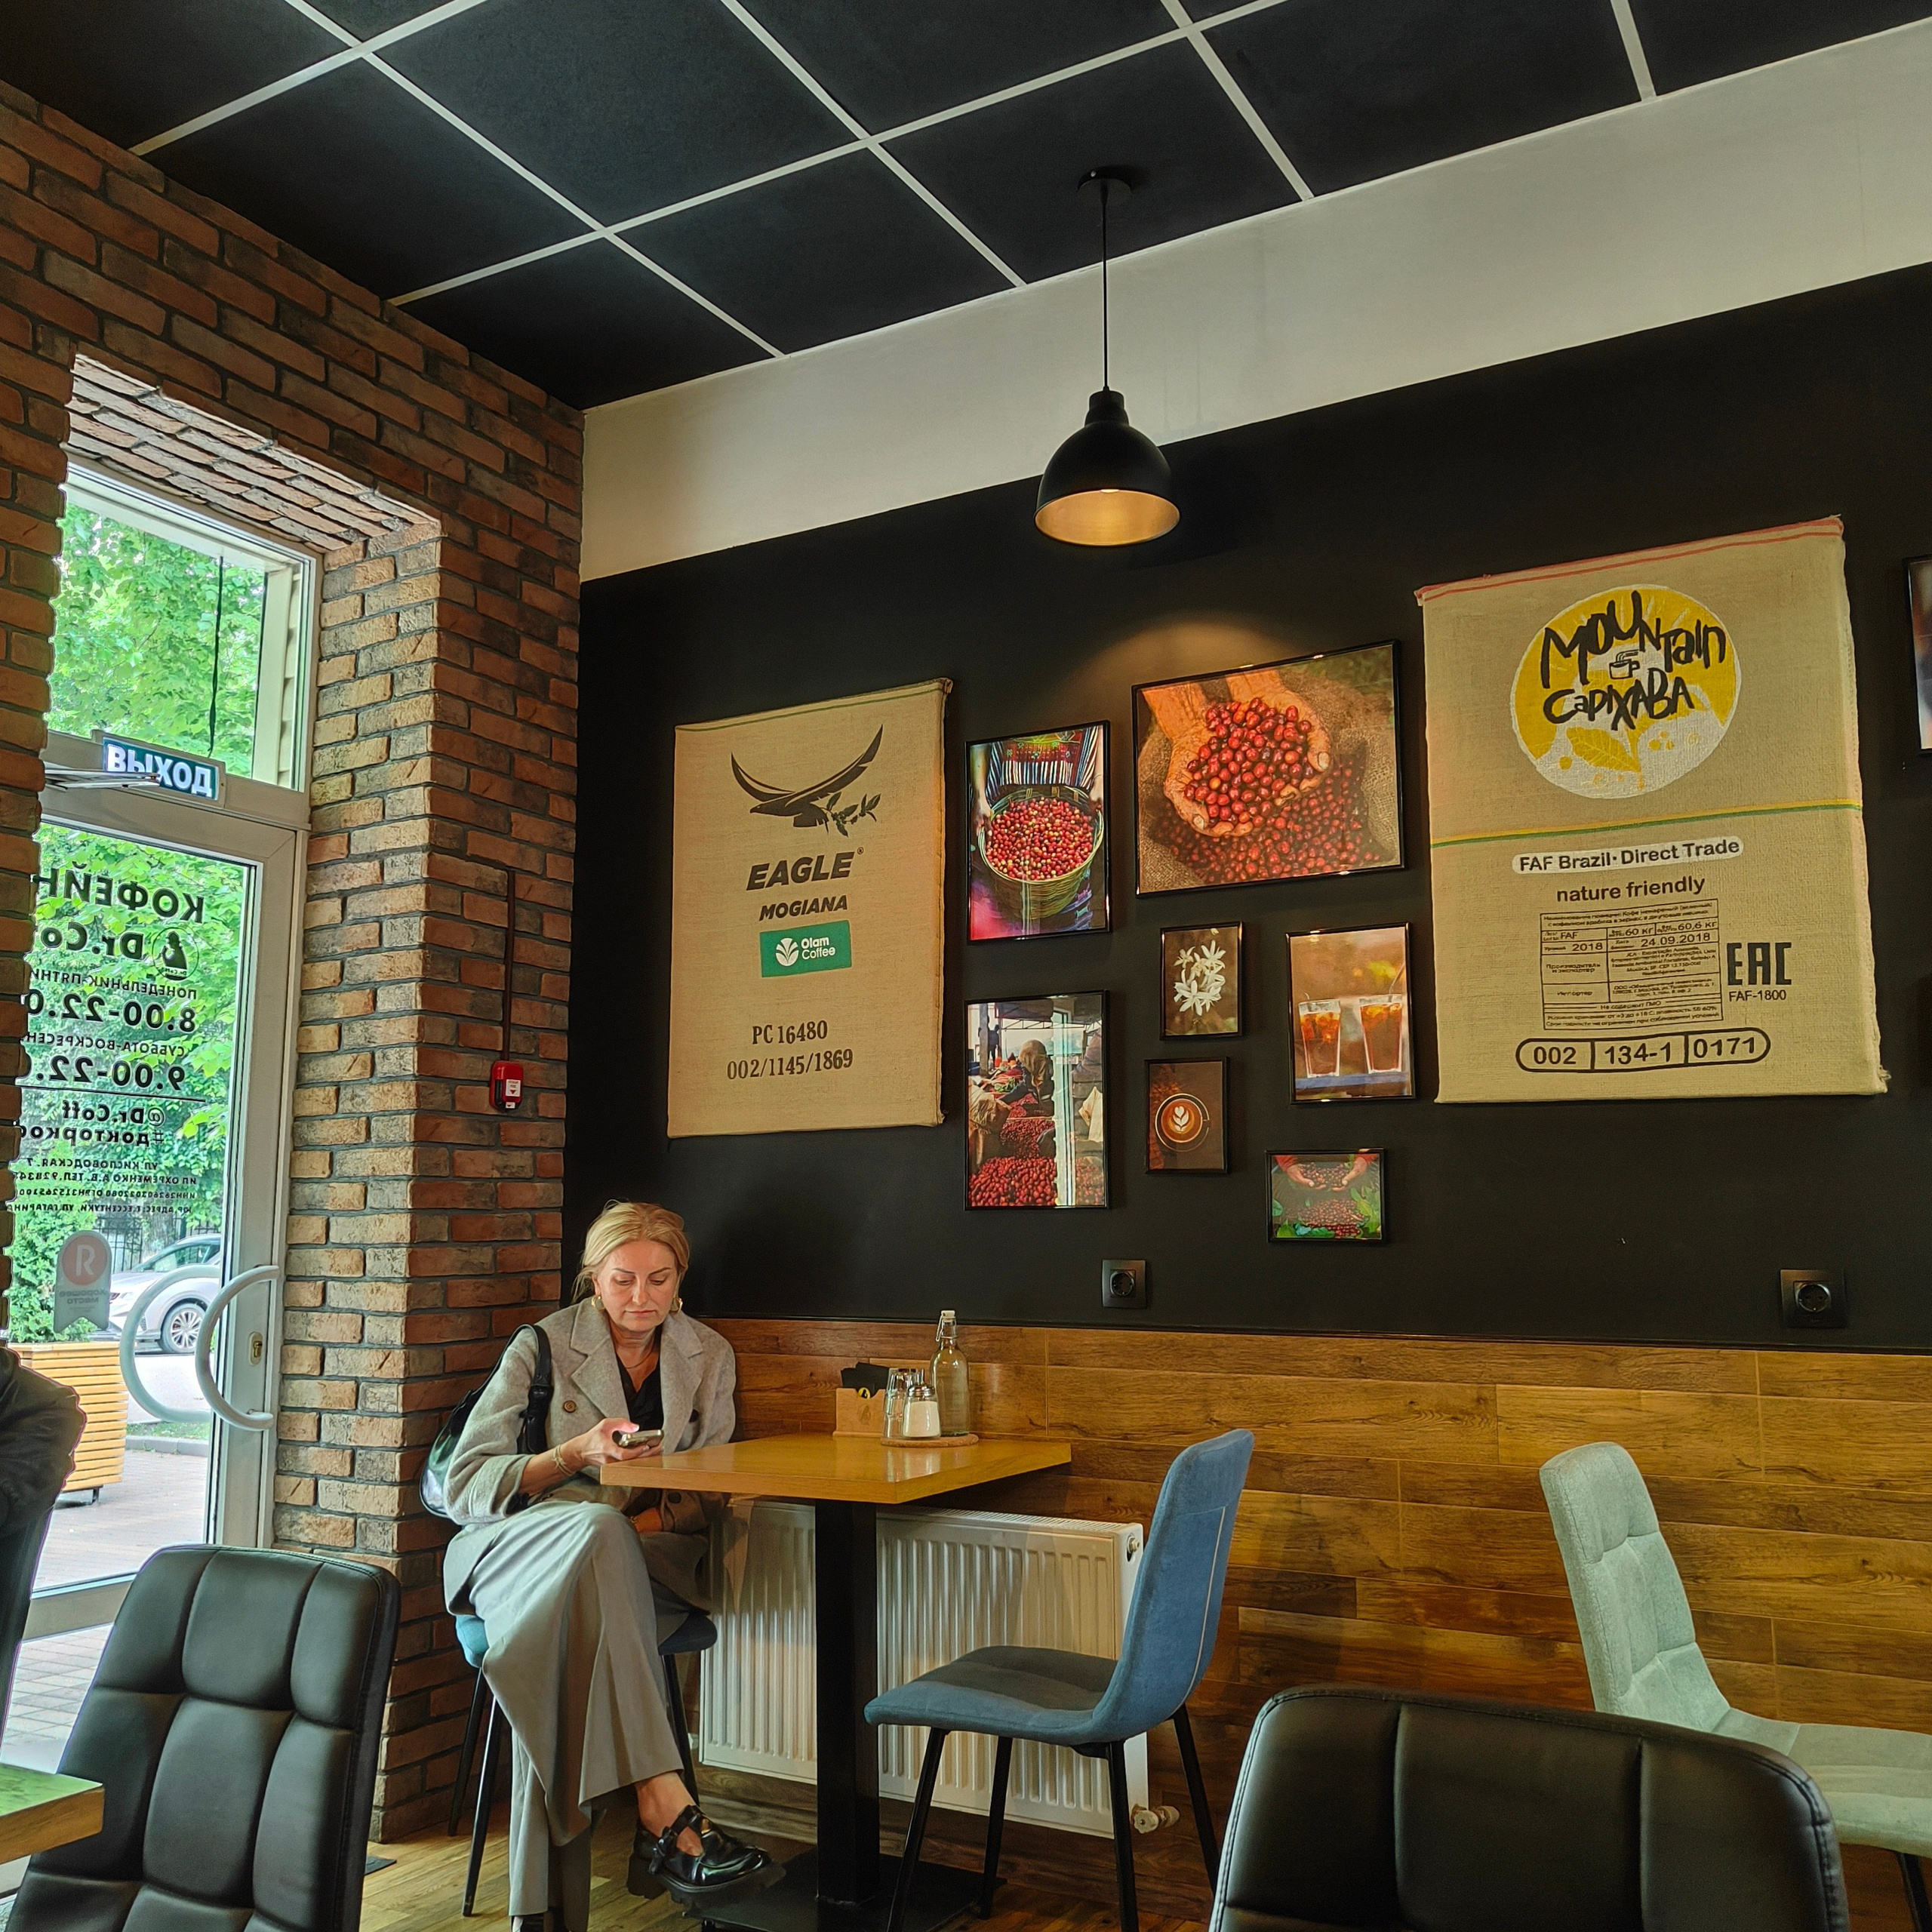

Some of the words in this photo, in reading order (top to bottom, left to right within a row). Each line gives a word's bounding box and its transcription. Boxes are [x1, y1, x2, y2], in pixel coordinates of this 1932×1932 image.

[107, 743, 212, 798] ВЫХОД
[1519, 856, 1553, 871] FAF
[1620, 844, 1680, 865] Direct
[1683, 839, 1740, 857] Trade
[1557, 885, 1621, 902] nature
[1626, 875, 1706, 898] friendly
[758, 895, 848, 921] MOGIANA
[1561, 931, 1578, 940] FAF
[1625, 928, 1639, 936] 60
[1678, 921, 1702, 931] 60,6
[801, 937, 829, 949] Olam
[1572, 942, 1603, 951] 2018
[1641, 932, 1710, 948] 24.09.2018
[801, 946, 835, 960] Coffee
[1726, 942, 1792, 986] EAC
[1728, 989, 1787, 1002] FAF-1800
[752, 1024, 774, 1044] PC
[777, 1020, 828, 1044] 16480
[1534, 1046, 1577, 1065] 002
[1604, 1041, 1672, 1062] 134-1
[1693, 1036, 1755, 1058] 0171
[727, 1048, 854, 1080] 002/1145/1869
